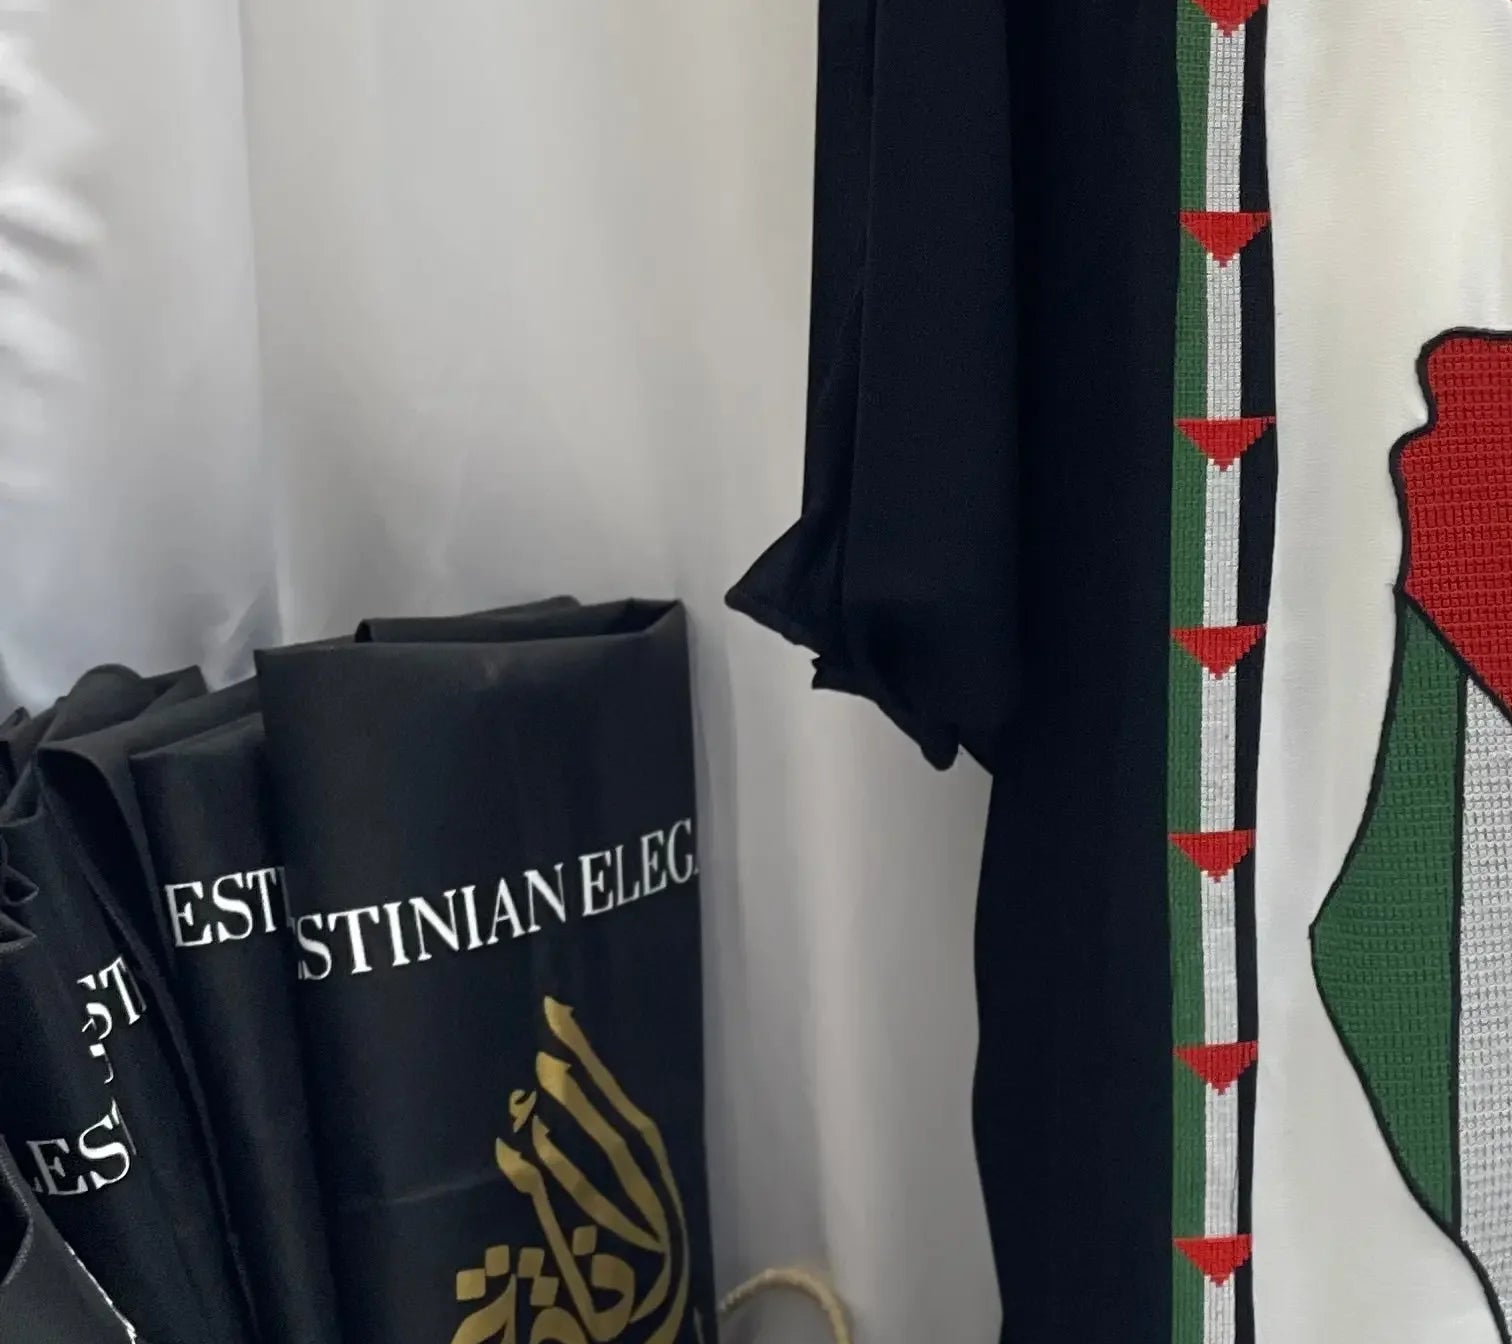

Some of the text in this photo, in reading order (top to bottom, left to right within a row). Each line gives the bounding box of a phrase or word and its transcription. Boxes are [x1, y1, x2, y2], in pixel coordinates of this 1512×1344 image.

[165, 866, 290, 948] EST
[297, 818, 699, 981] STINIAN ELEG
[27, 1098, 135, 1196] ES
